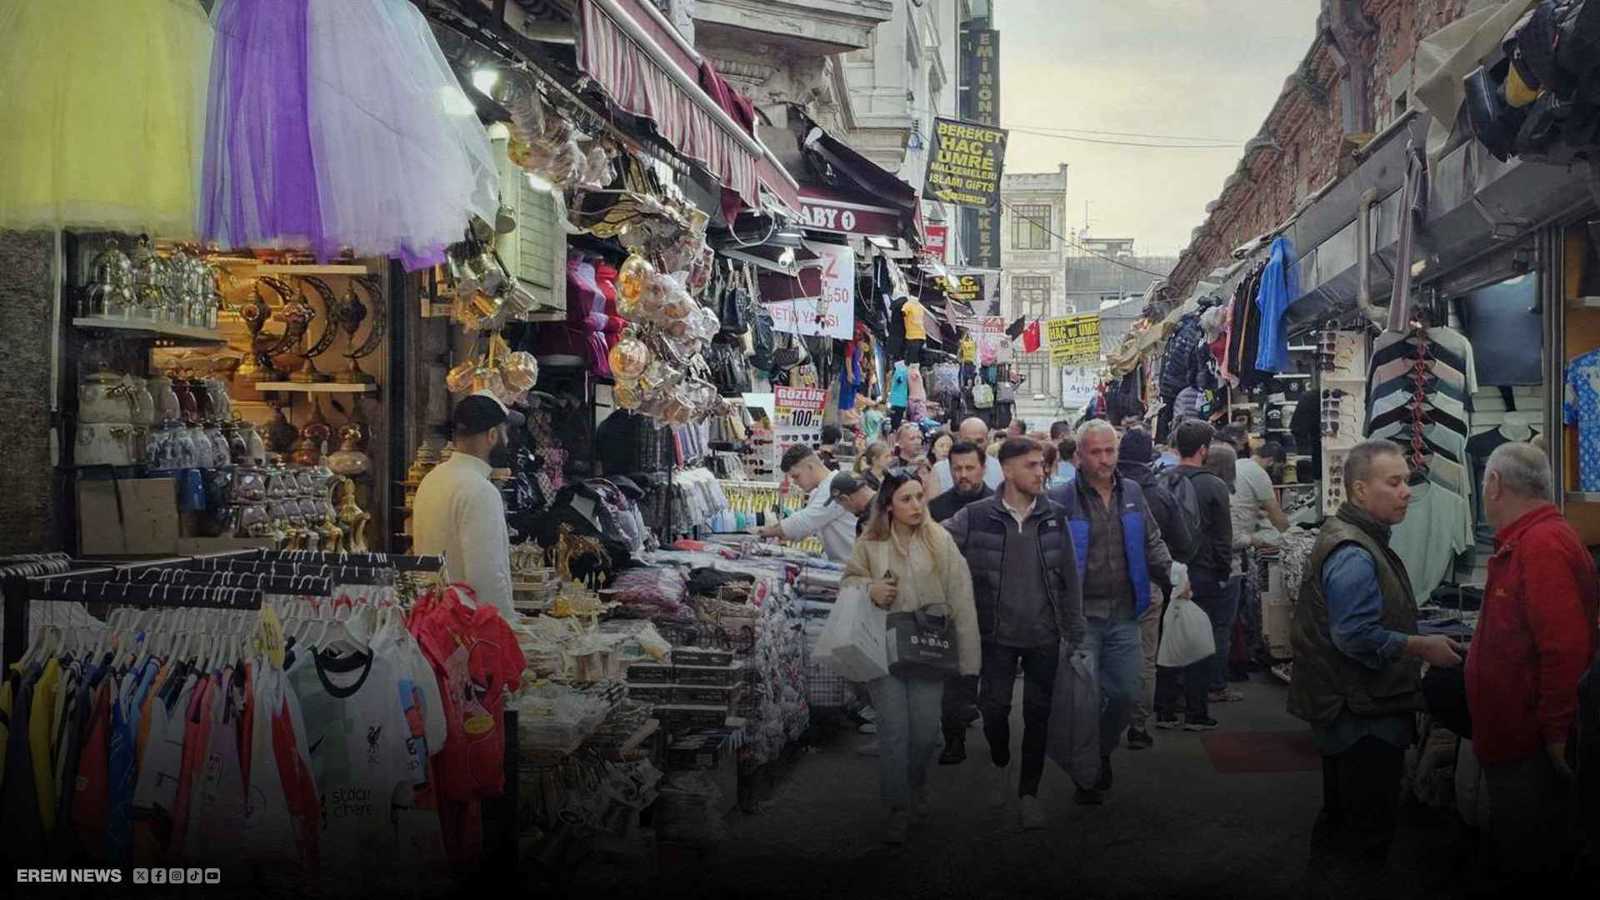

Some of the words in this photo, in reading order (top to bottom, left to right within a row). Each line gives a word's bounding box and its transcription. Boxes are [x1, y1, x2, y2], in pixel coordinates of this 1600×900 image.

[938, 122, 1003, 143] BEREKET
[941, 136, 984, 155] HAC
[800, 205, 838, 229] ABY
[791, 409, 812, 427] 100
